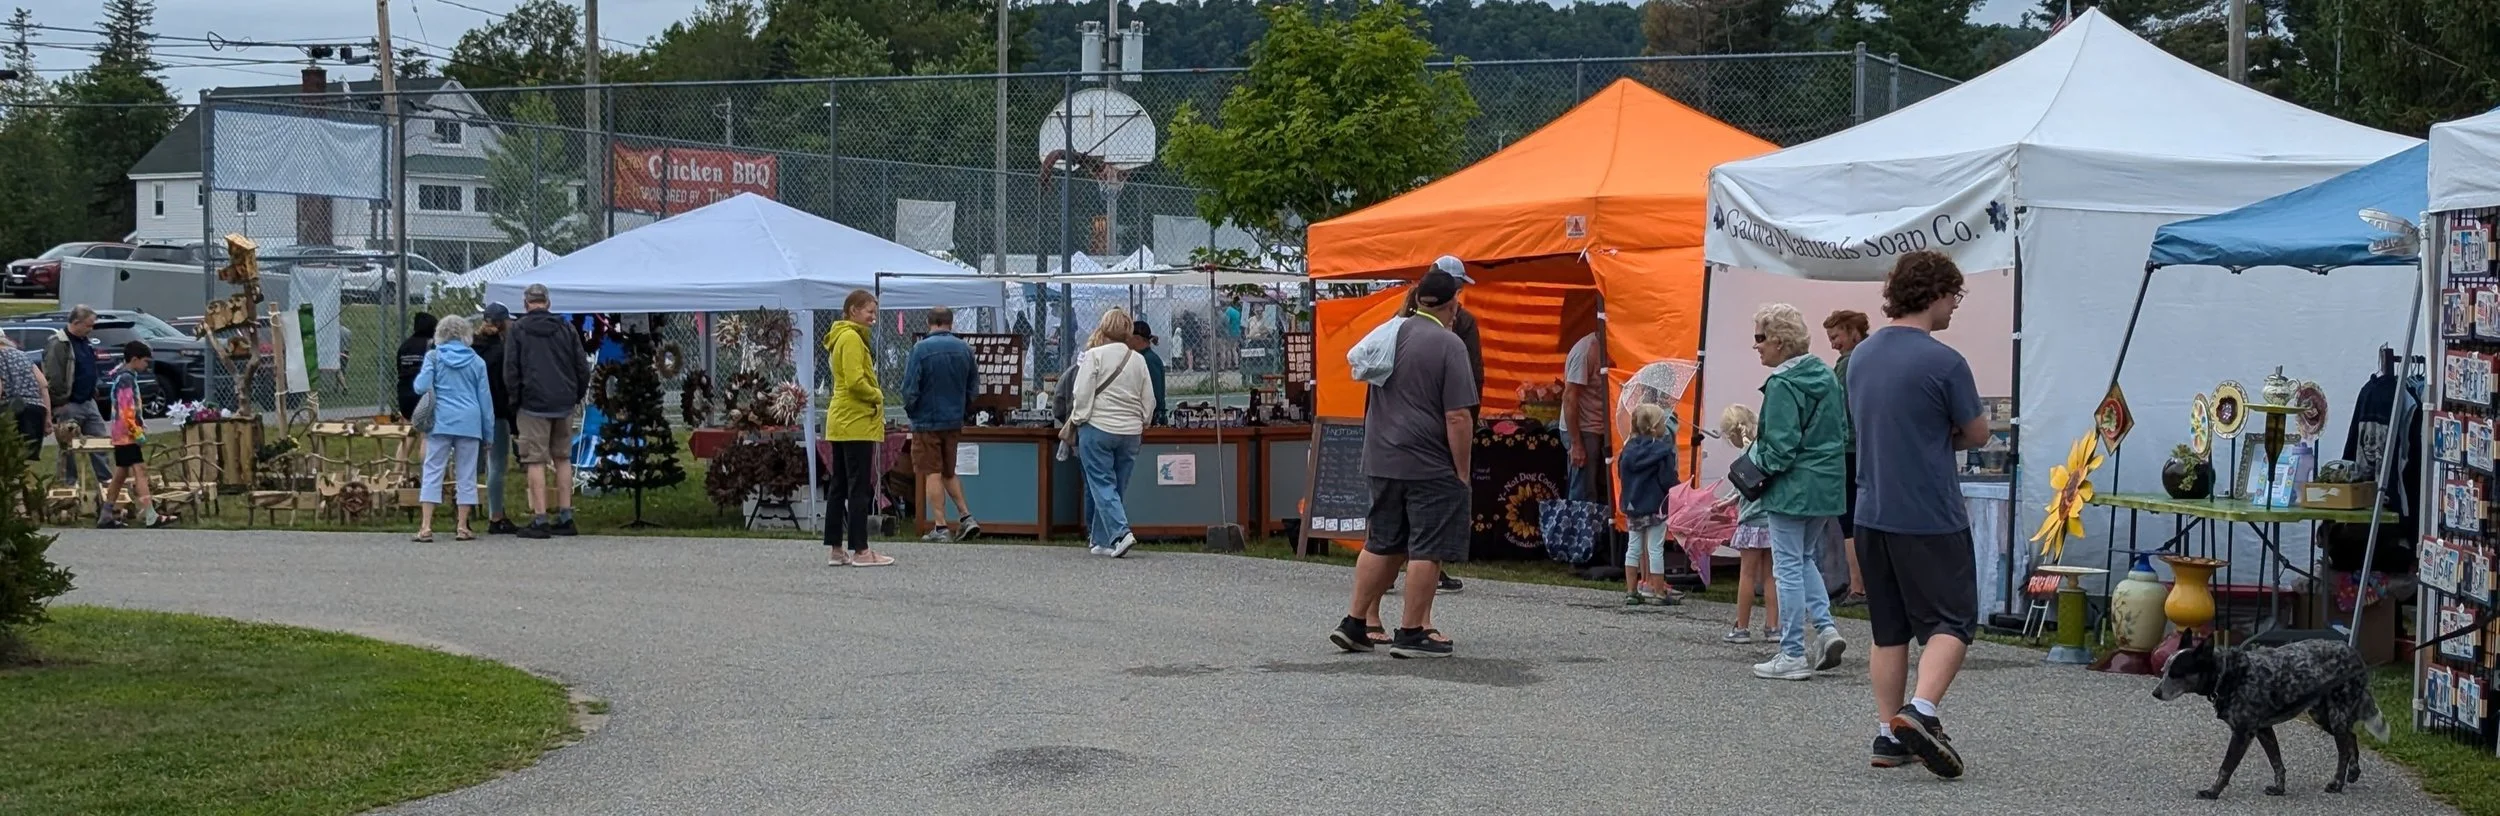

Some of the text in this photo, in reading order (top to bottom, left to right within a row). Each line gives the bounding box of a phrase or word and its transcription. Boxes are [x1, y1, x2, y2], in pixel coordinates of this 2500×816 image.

[731, 160, 770, 189] BBQ
[640, 186, 687, 204] SPONRED
[1775, 227, 1861, 260] Naturals
[1863, 229, 1927, 259] Soap
[1932, 214, 1981, 246] Co.
[1519, 472, 1537, 483] Dog
[1537, 472, 1560, 499] Cookie
[2432, 554, 2453, 581] USAF
